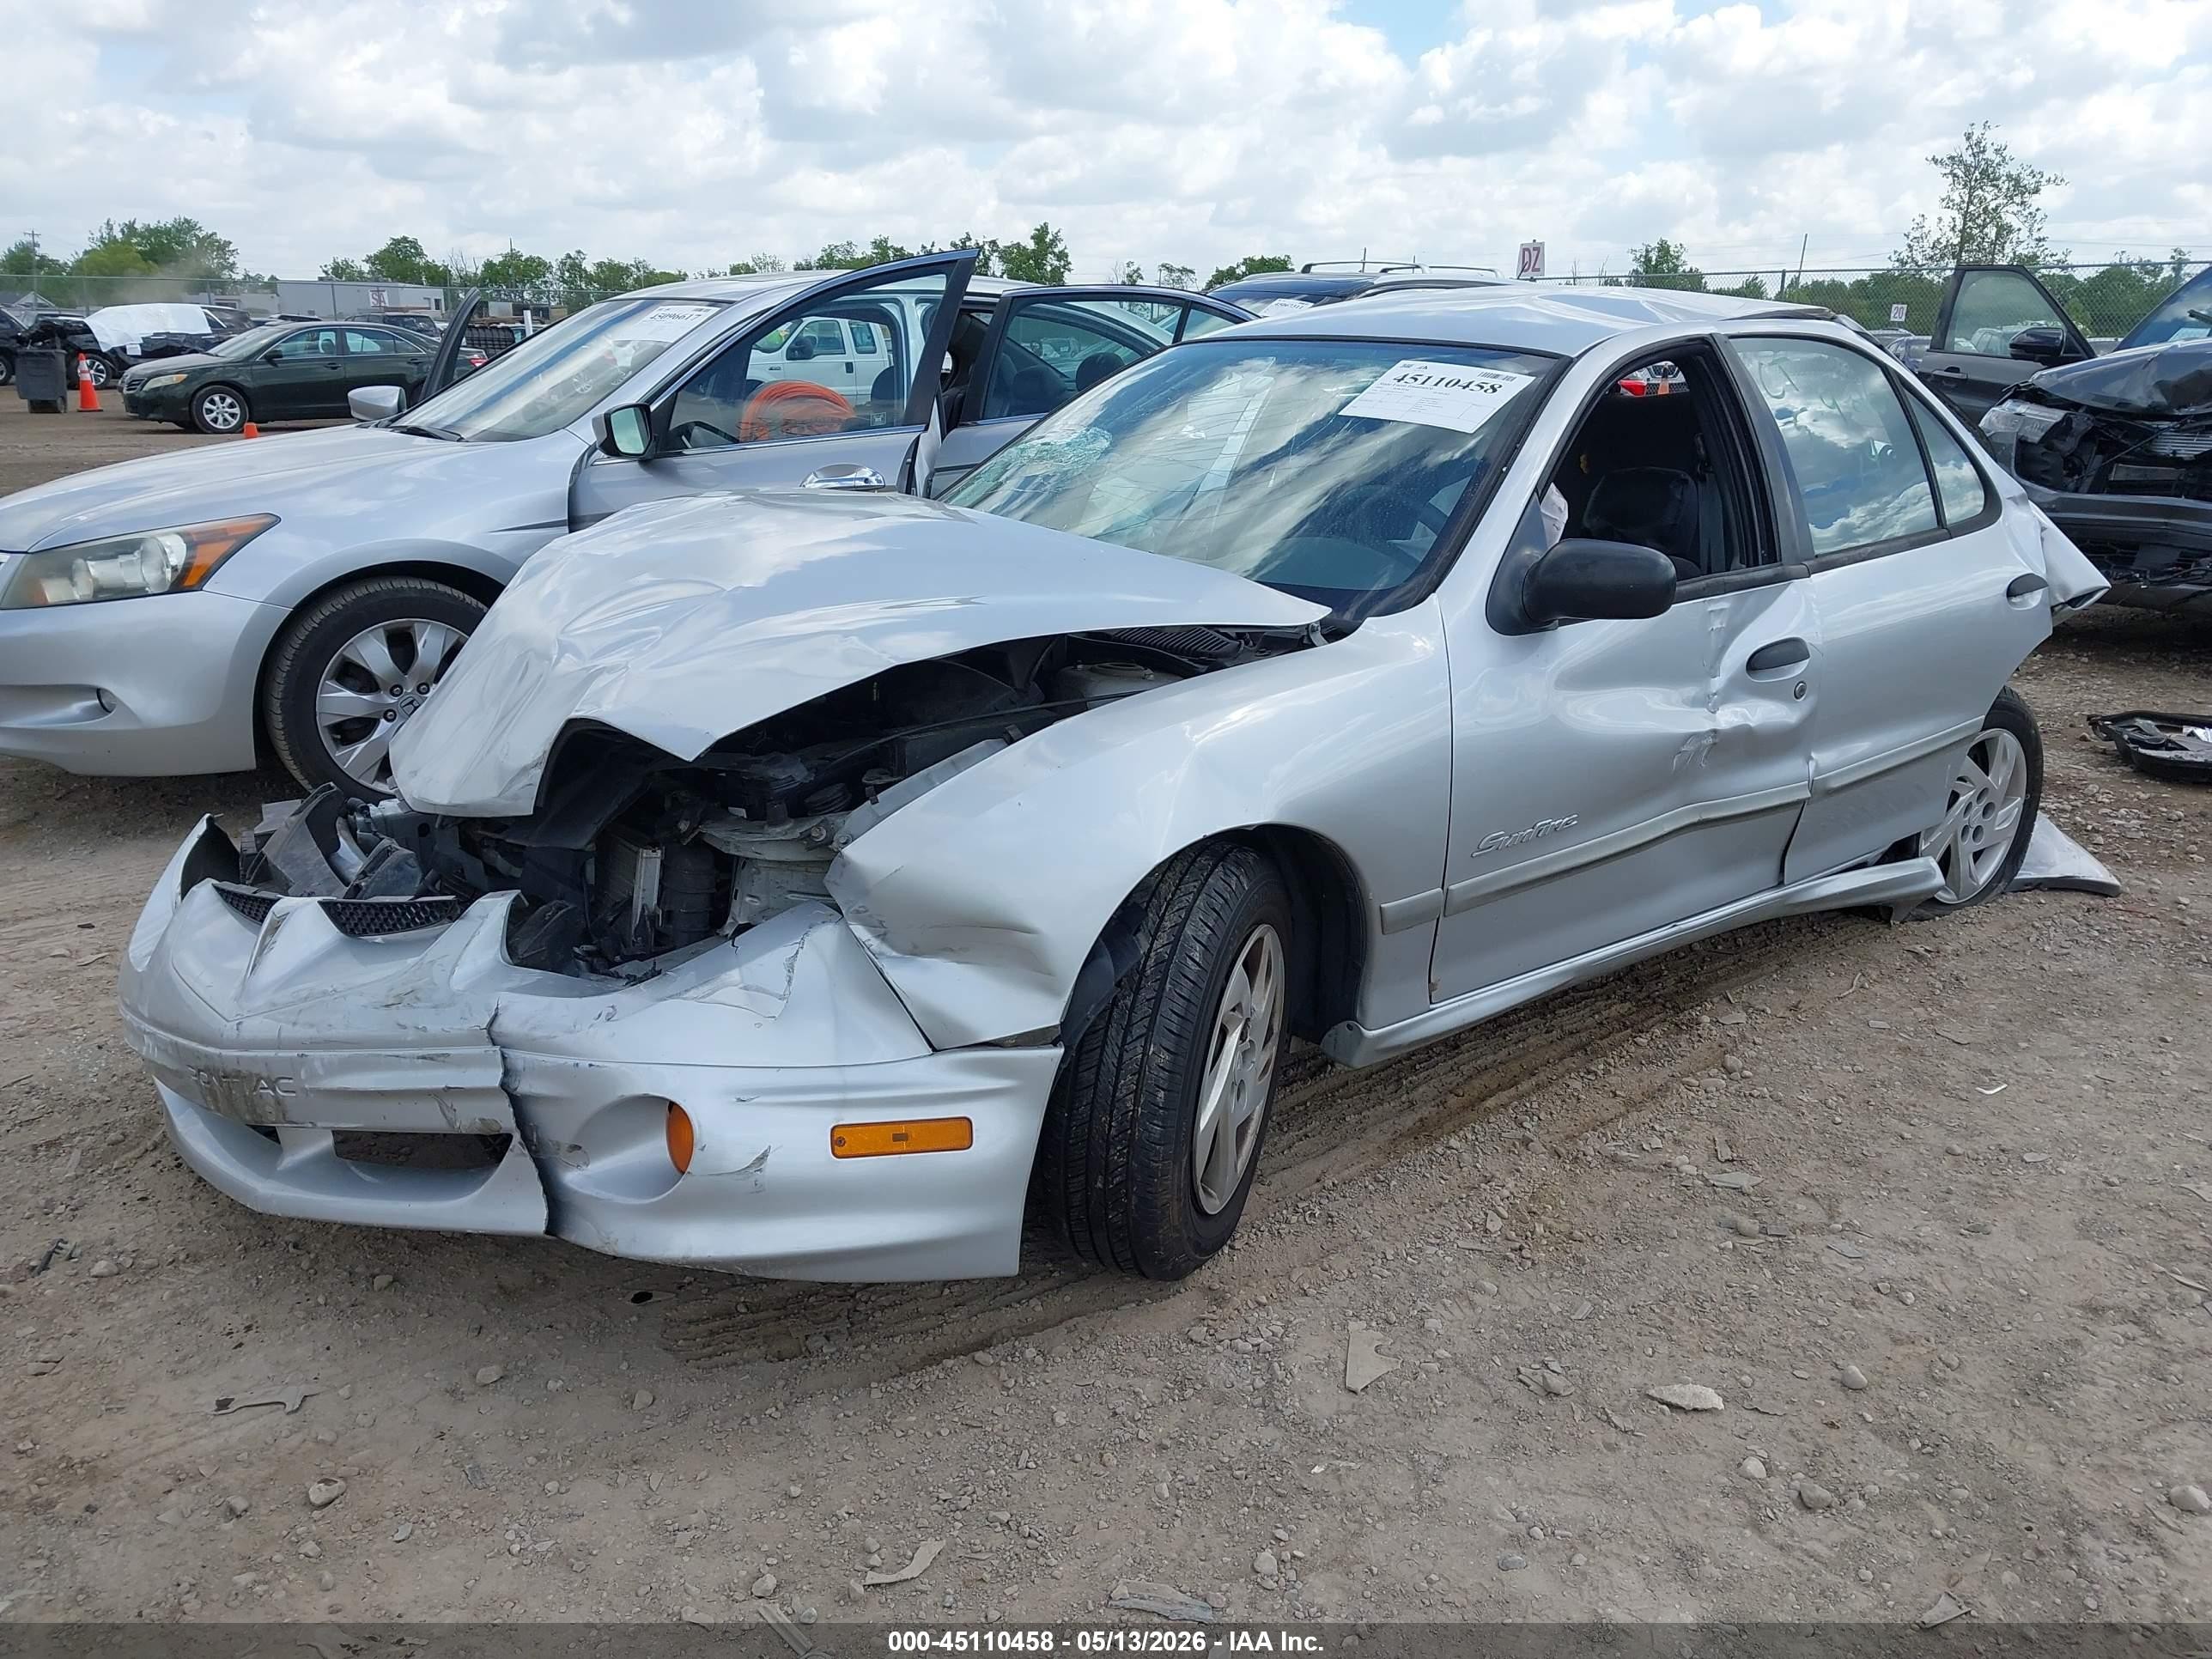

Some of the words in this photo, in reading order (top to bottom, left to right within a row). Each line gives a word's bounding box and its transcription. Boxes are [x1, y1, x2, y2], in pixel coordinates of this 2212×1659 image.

[1893, 306, 1905, 319] 20
[1393, 373, 1504, 396] 45110458
[185, 1063, 296, 1097] PONTAC
